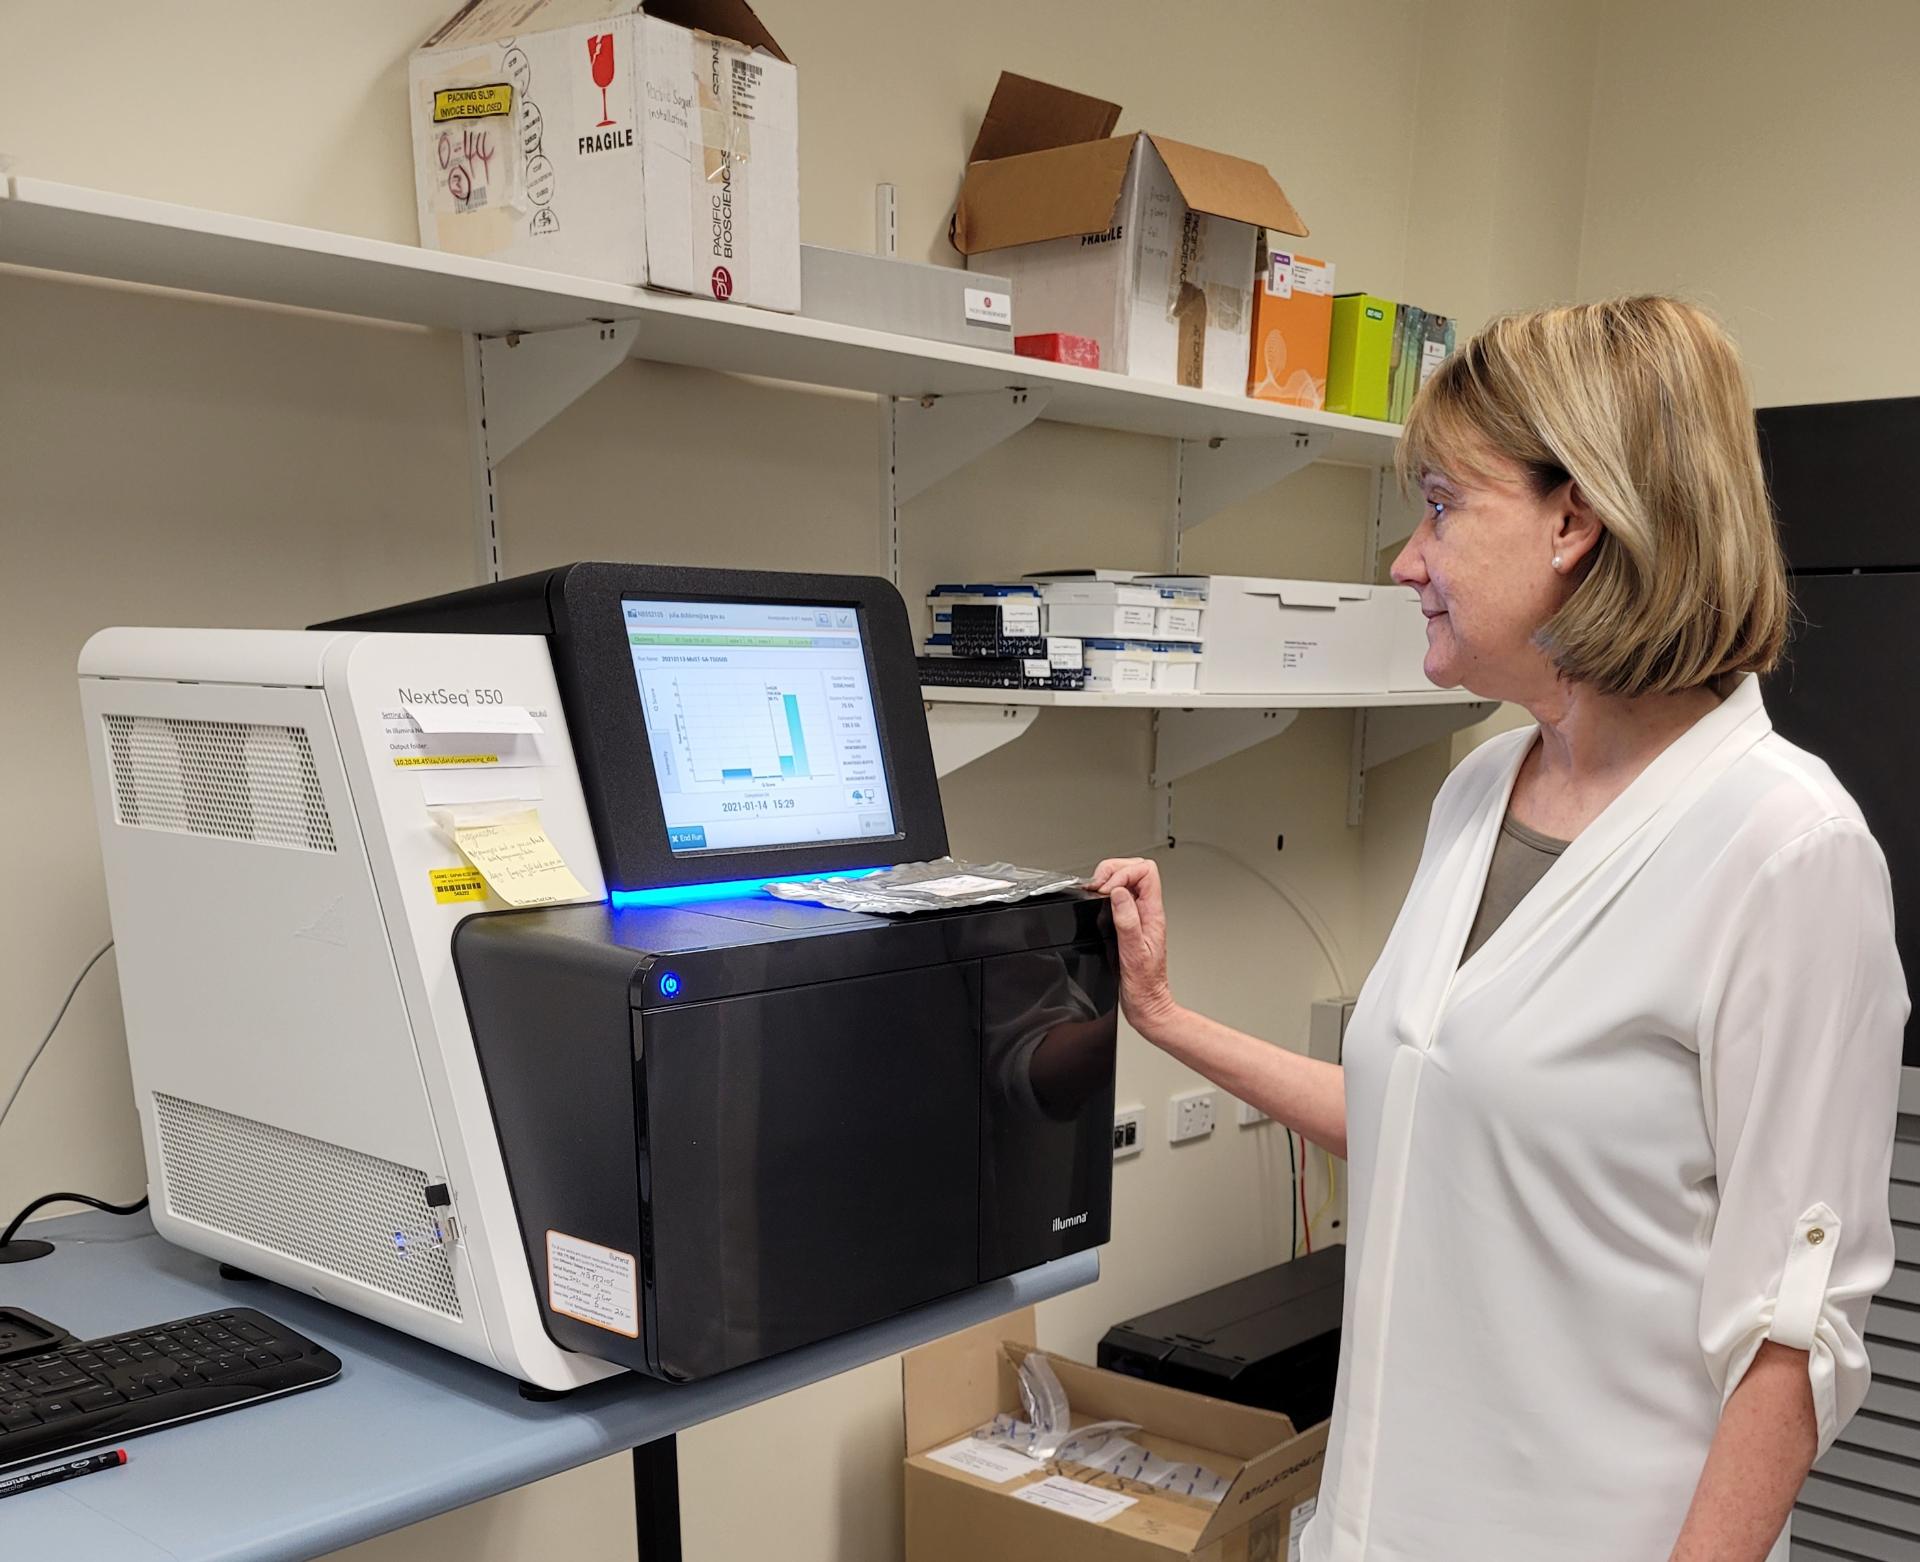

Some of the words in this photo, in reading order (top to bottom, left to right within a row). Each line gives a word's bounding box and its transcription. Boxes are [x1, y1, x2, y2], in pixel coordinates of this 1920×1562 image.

[447, 91, 478, 103] PACKING
[440, 105, 466, 118] INVOICE
[467, 102, 502, 114] ENCLOSED
[578, 128, 633, 155] FRAGILE
[721, 149, 733, 259] BIOSCIENCES
[713, 194, 722, 258] PACIFIC
[398, 687, 469, 708] NextSeq
[475, 688, 503, 705] 550
[721, 801, 769, 813] 2021-01-14
[773, 798, 795, 809] 15:29
[1052, 1212, 1088, 1233] illumina
[31, 1466, 66, 1480] permanent
